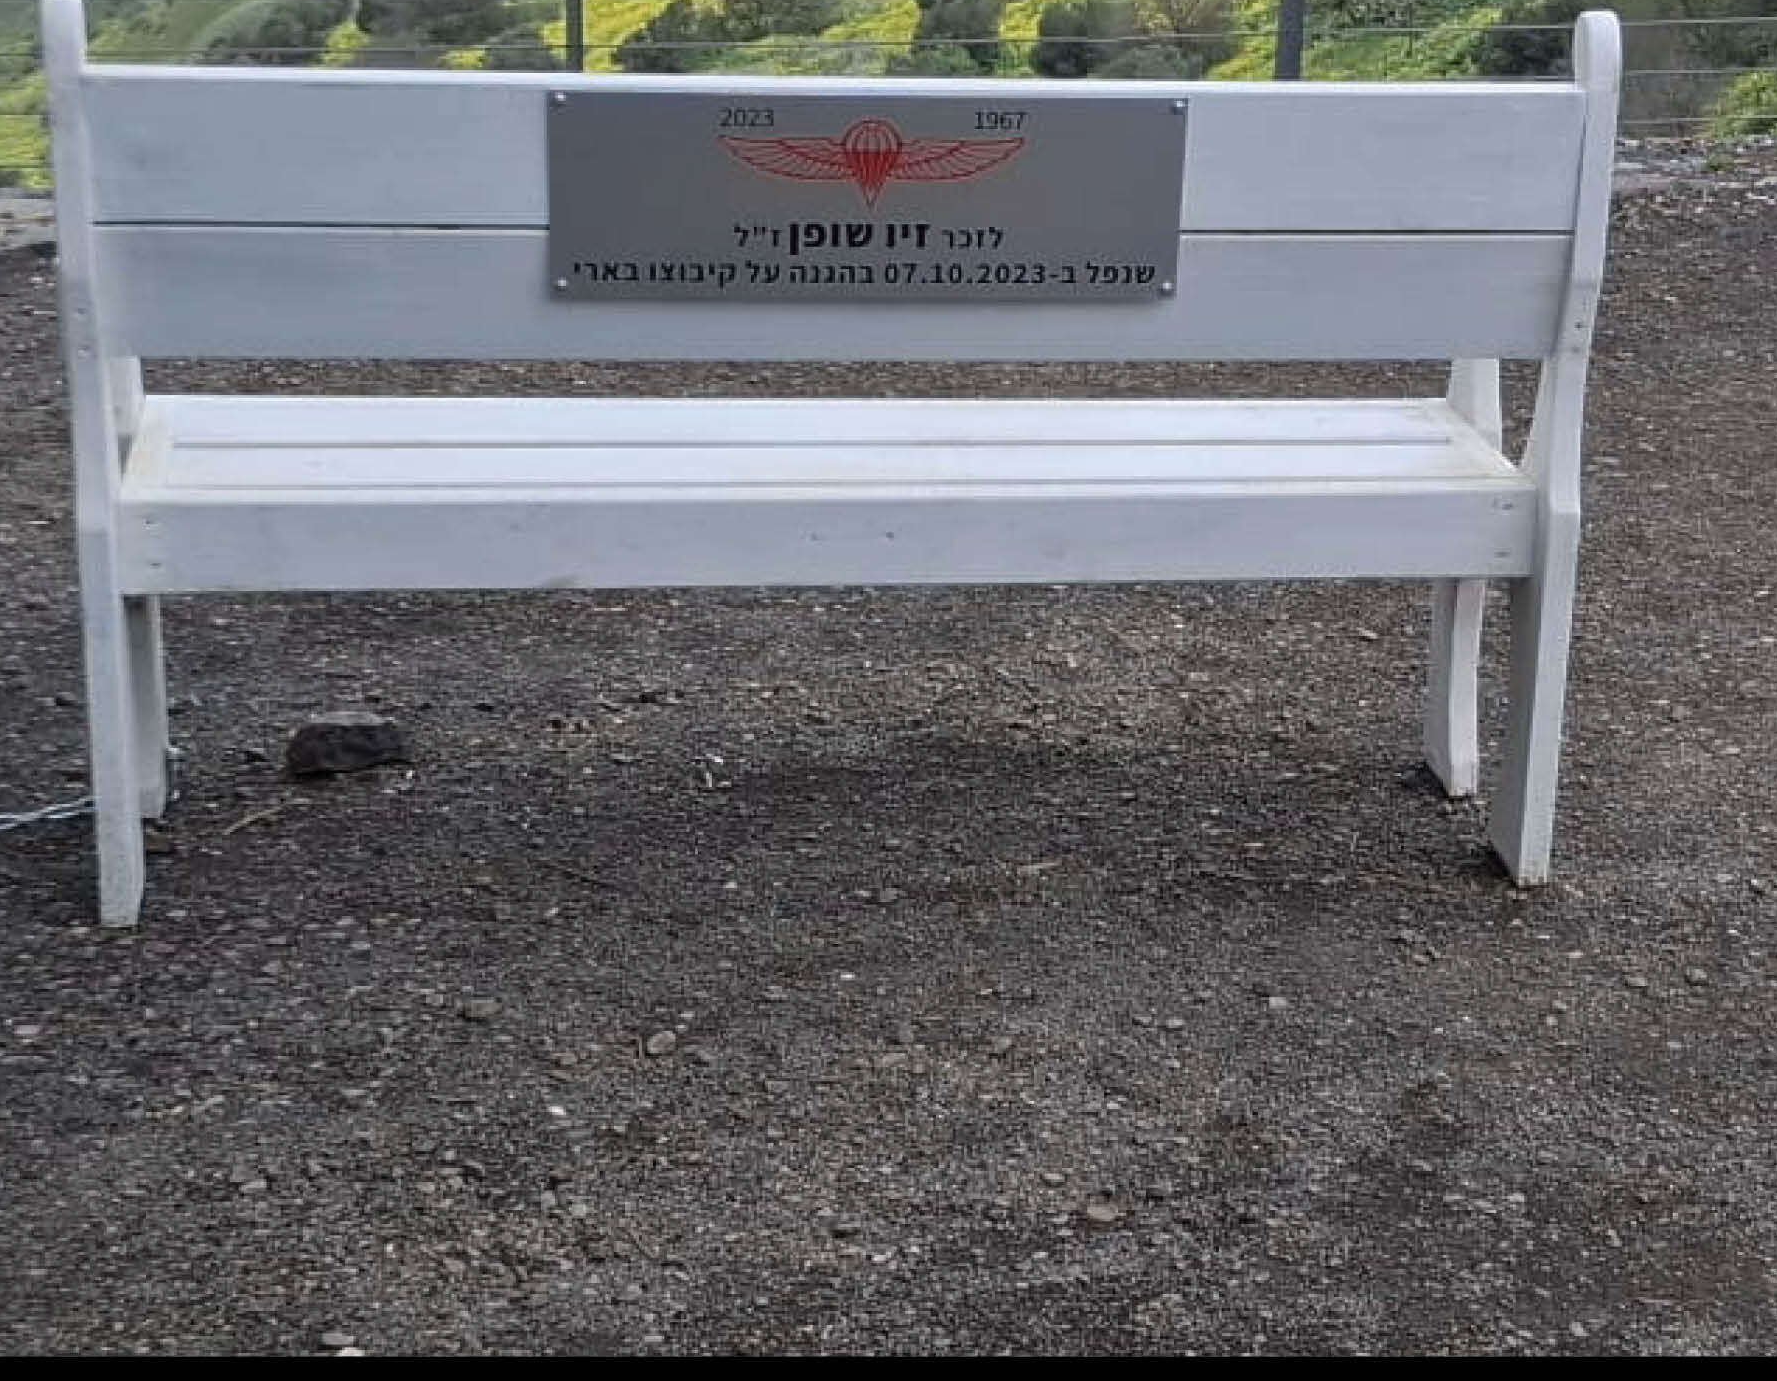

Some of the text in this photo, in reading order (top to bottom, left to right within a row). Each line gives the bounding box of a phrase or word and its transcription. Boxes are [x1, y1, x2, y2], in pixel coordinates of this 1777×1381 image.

[719, 107, 775, 127] 2023
[975, 110, 1028, 130] 1967
[789, 221, 873, 256] שופן
[886, 223, 931, 249] זיו
[942, 225, 1004, 249] לזכר
[573, 261, 640, 283] בארי
[648, 261, 737, 288] קיבוצו
[744, 260, 781, 284] על
[790, 263, 875, 284] בהגנה
[1087, 260, 1156, 284] שנפל
